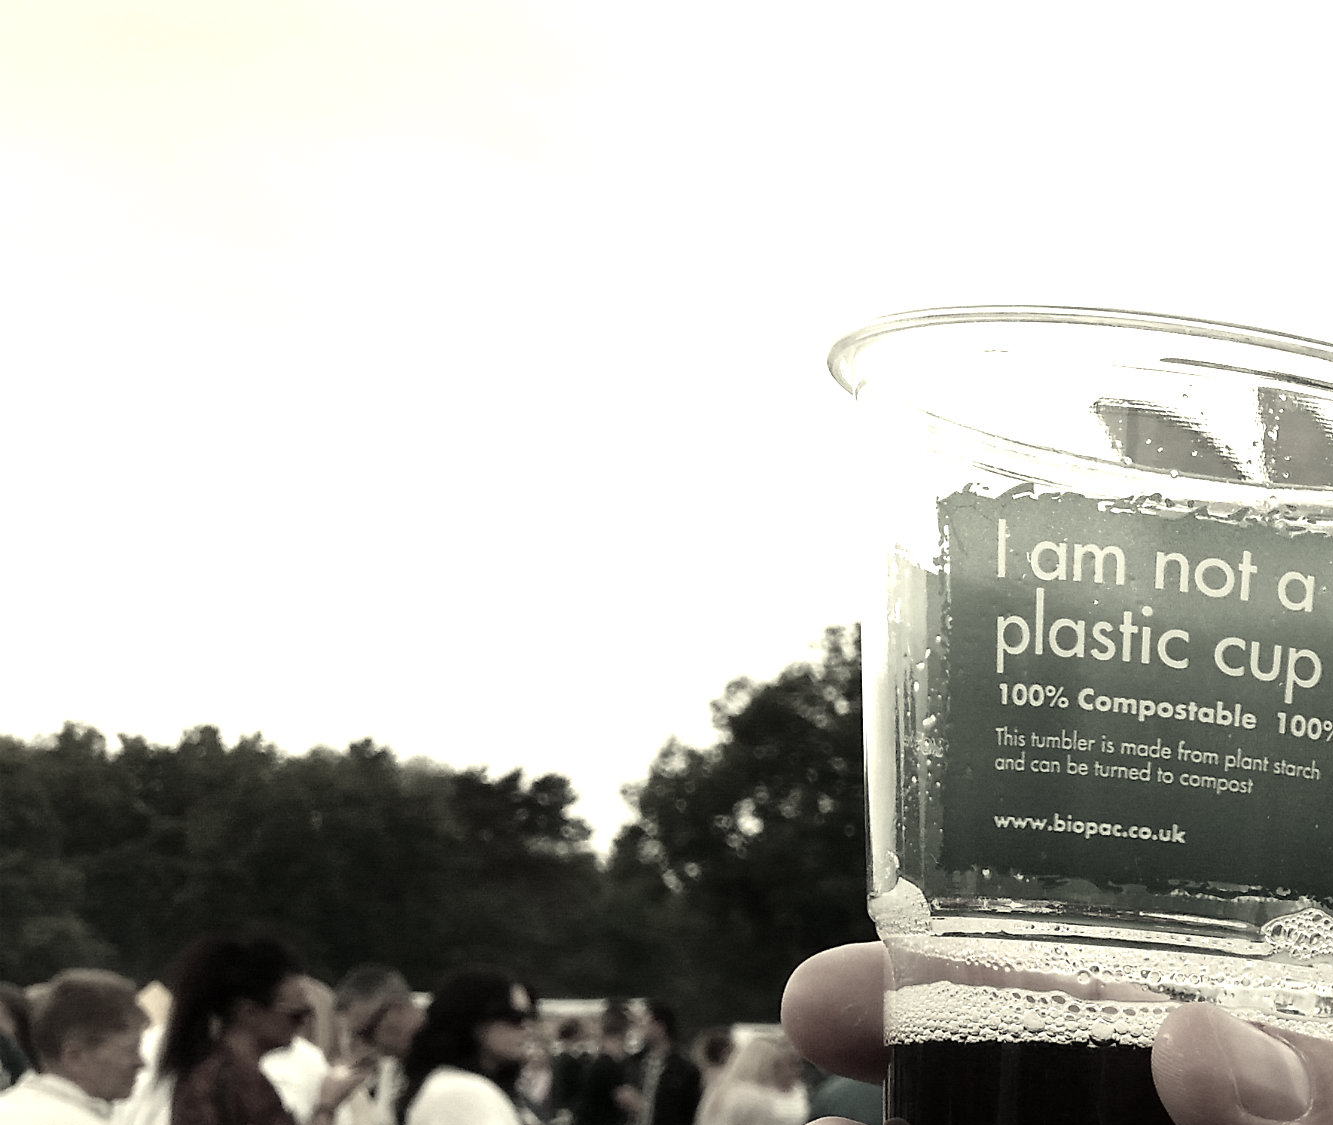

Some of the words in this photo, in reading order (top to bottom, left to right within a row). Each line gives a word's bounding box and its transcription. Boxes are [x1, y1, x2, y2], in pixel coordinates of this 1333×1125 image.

[997, 518, 1006, 578] I
[1030, 540, 1126, 585] am
[1154, 550, 1258, 601] not
[1277, 571, 1315, 612] a
[996, 587, 1191, 674] plastic
[1214, 636, 1322, 704] cup
[999, 683, 1070, 708] 100%
[1077, 687, 1257, 730] Compostable
[994, 752, 1026, 772] and
[1030, 759, 1061, 773] can
[1066, 754, 1088, 776] be
[1094, 760, 1151, 782] turned
[1157, 767, 1174, 784] to
[1179, 772, 1254, 794] compost
[995, 727, 1026, 747] This
[1030, 729, 1096, 752] tumbler
[1100, 735, 1115, 753] is
[1120, 738, 1172, 760] made
[1177, 740, 1219, 766] from
[1224, 748, 1269, 772] plant
[1272, 760, 1321, 780] starch
[993, 813, 1187, 844] www.biopac.co.uk
